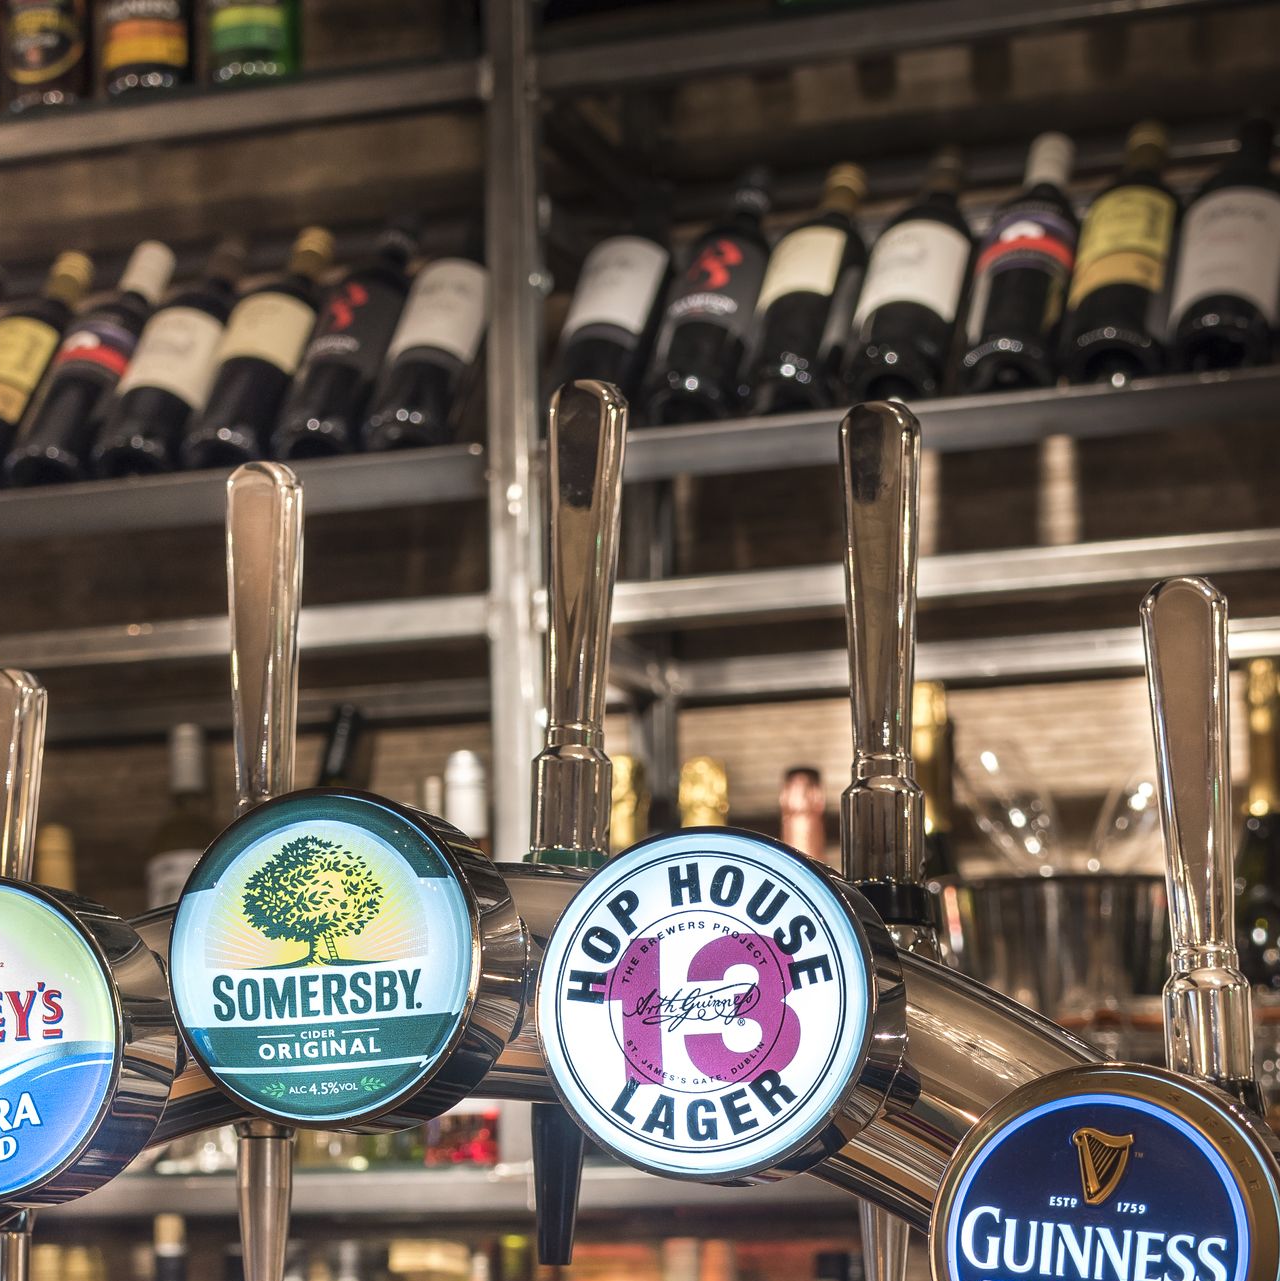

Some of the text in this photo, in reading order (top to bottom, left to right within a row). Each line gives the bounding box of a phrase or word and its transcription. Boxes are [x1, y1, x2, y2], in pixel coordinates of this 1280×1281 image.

[567, 862, 834, 1004] HOP HOUSE
[622, 921, 768, 984] THE BREWERS PROJECT
[600, 933, 801, 1086] 13
[258, 1036, 382, 1060] ORIGINAL
[300, 1029, 335, 1040] CIDER
[626, 1039, 638, 1057] ST.
[641, 1059, 686, 1084] JAMES'S
[730, 1041, 765, 1075] DUBLIN
[289, 1085, 308, 1095] ALC
[339, 1082, 359, 1092] VOL
[611, 1069, 798, 1141] LAGER
[1116, 1201, 1146, 1214] 1759
